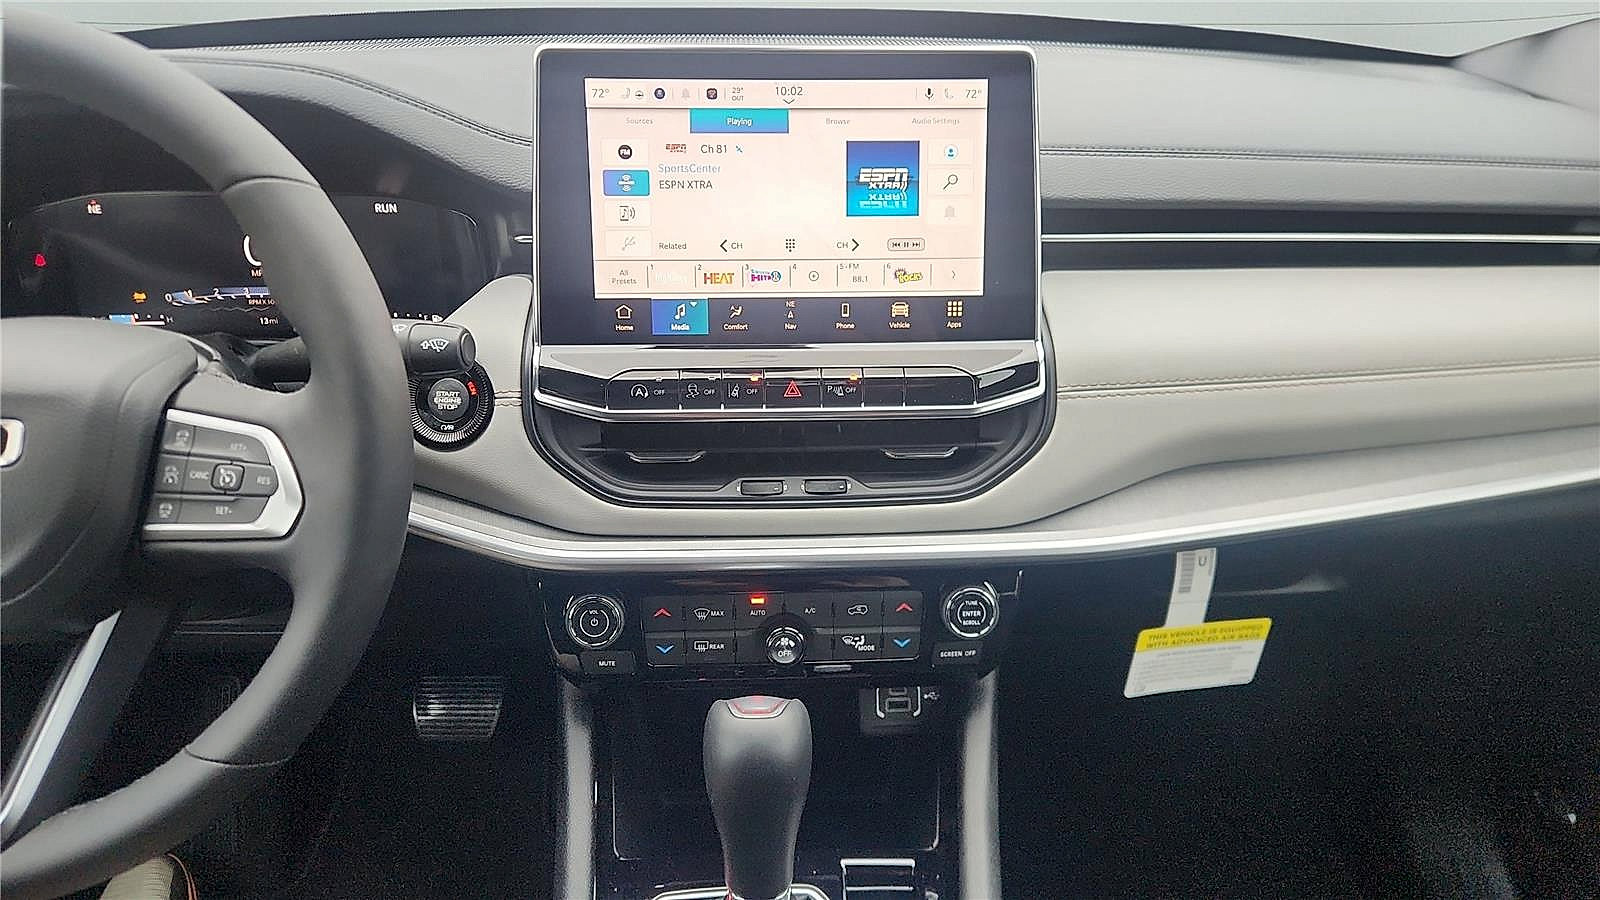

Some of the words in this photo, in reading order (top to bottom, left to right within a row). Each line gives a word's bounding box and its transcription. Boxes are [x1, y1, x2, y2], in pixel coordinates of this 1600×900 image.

[775, 86, 803, 96] 10:02
[626, 117, 653, 125] Sources
[727, 117, 752, 127] Playing
[912, 117, 933, 125] Audio
[934, 117, 960, 126] Settings
[700, 144, 714, 154] Ch
[716, 144, 728, 154] 81
[658, 164, 721, 175] SportsCenter
[859, 167, 909, 182] ESPN
[659, 180, 685, 190] ESPN
[686, 180, 713, 190] XTRA
[87, 204, 103, 214] NE
[374, 203, 398, 214] RUN
[658, 242, 687, 250] Related
[731, 242, 743, 250] CH
[836, 241, 849, 249] CH
[703, 272, 735, 285] HEAT
[213, 287, 220, 296] 2
[615, 324, 634, 332] Home
[671, 324, 690, 332] Media
[723, 323, 749, 331] Comfort
[784, 323, 798, 331] Nav
[835, 322, 856, 330] Phone
[946, 321, 963, 330] Apps
[435, 390, 460, 398] START
[653, 388, 666, 396] OFF
[703, 388, 716, 396] OFF
[746, 388, 758, 396] OFF
[433, 396, 462, 405] ENGINE
[189, 471, 209, 480] CANC
[256, 475, 271, 485] RES
[750, 609, 766, 617] AUTO
[804, 606, 816, 614] A/C
[962, 609, 982, 618] ENTER
[709, 642, 725, 651] REAR
[776, 649, 792, 658] OFF
[940, 651, 963, 659] SCREEN
[965, 649, 978, 657] OFF
[598, 660, 616, 668] MUTE
